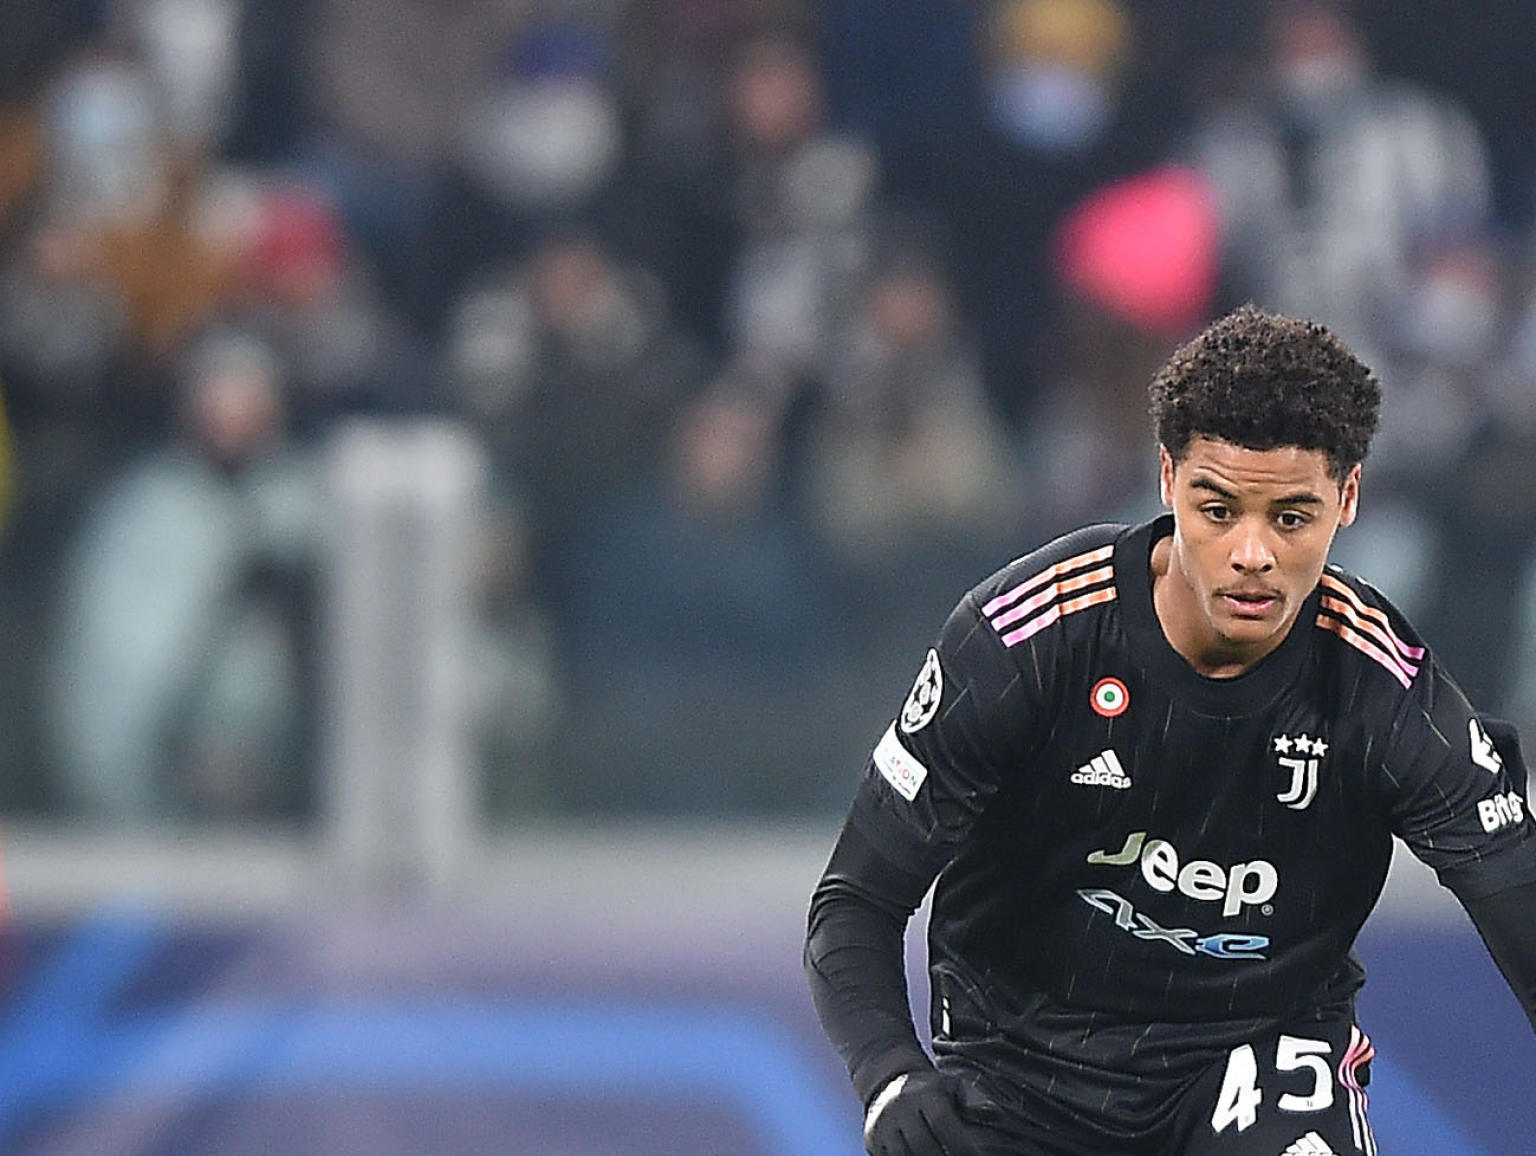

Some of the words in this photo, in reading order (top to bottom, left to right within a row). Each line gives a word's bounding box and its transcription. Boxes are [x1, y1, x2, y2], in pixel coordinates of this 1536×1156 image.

[1070, 771, 1132, 789] adidas
[1087, 832, 1278, 917] Jeep
[1211, 1034, 1334, 1132] 45
